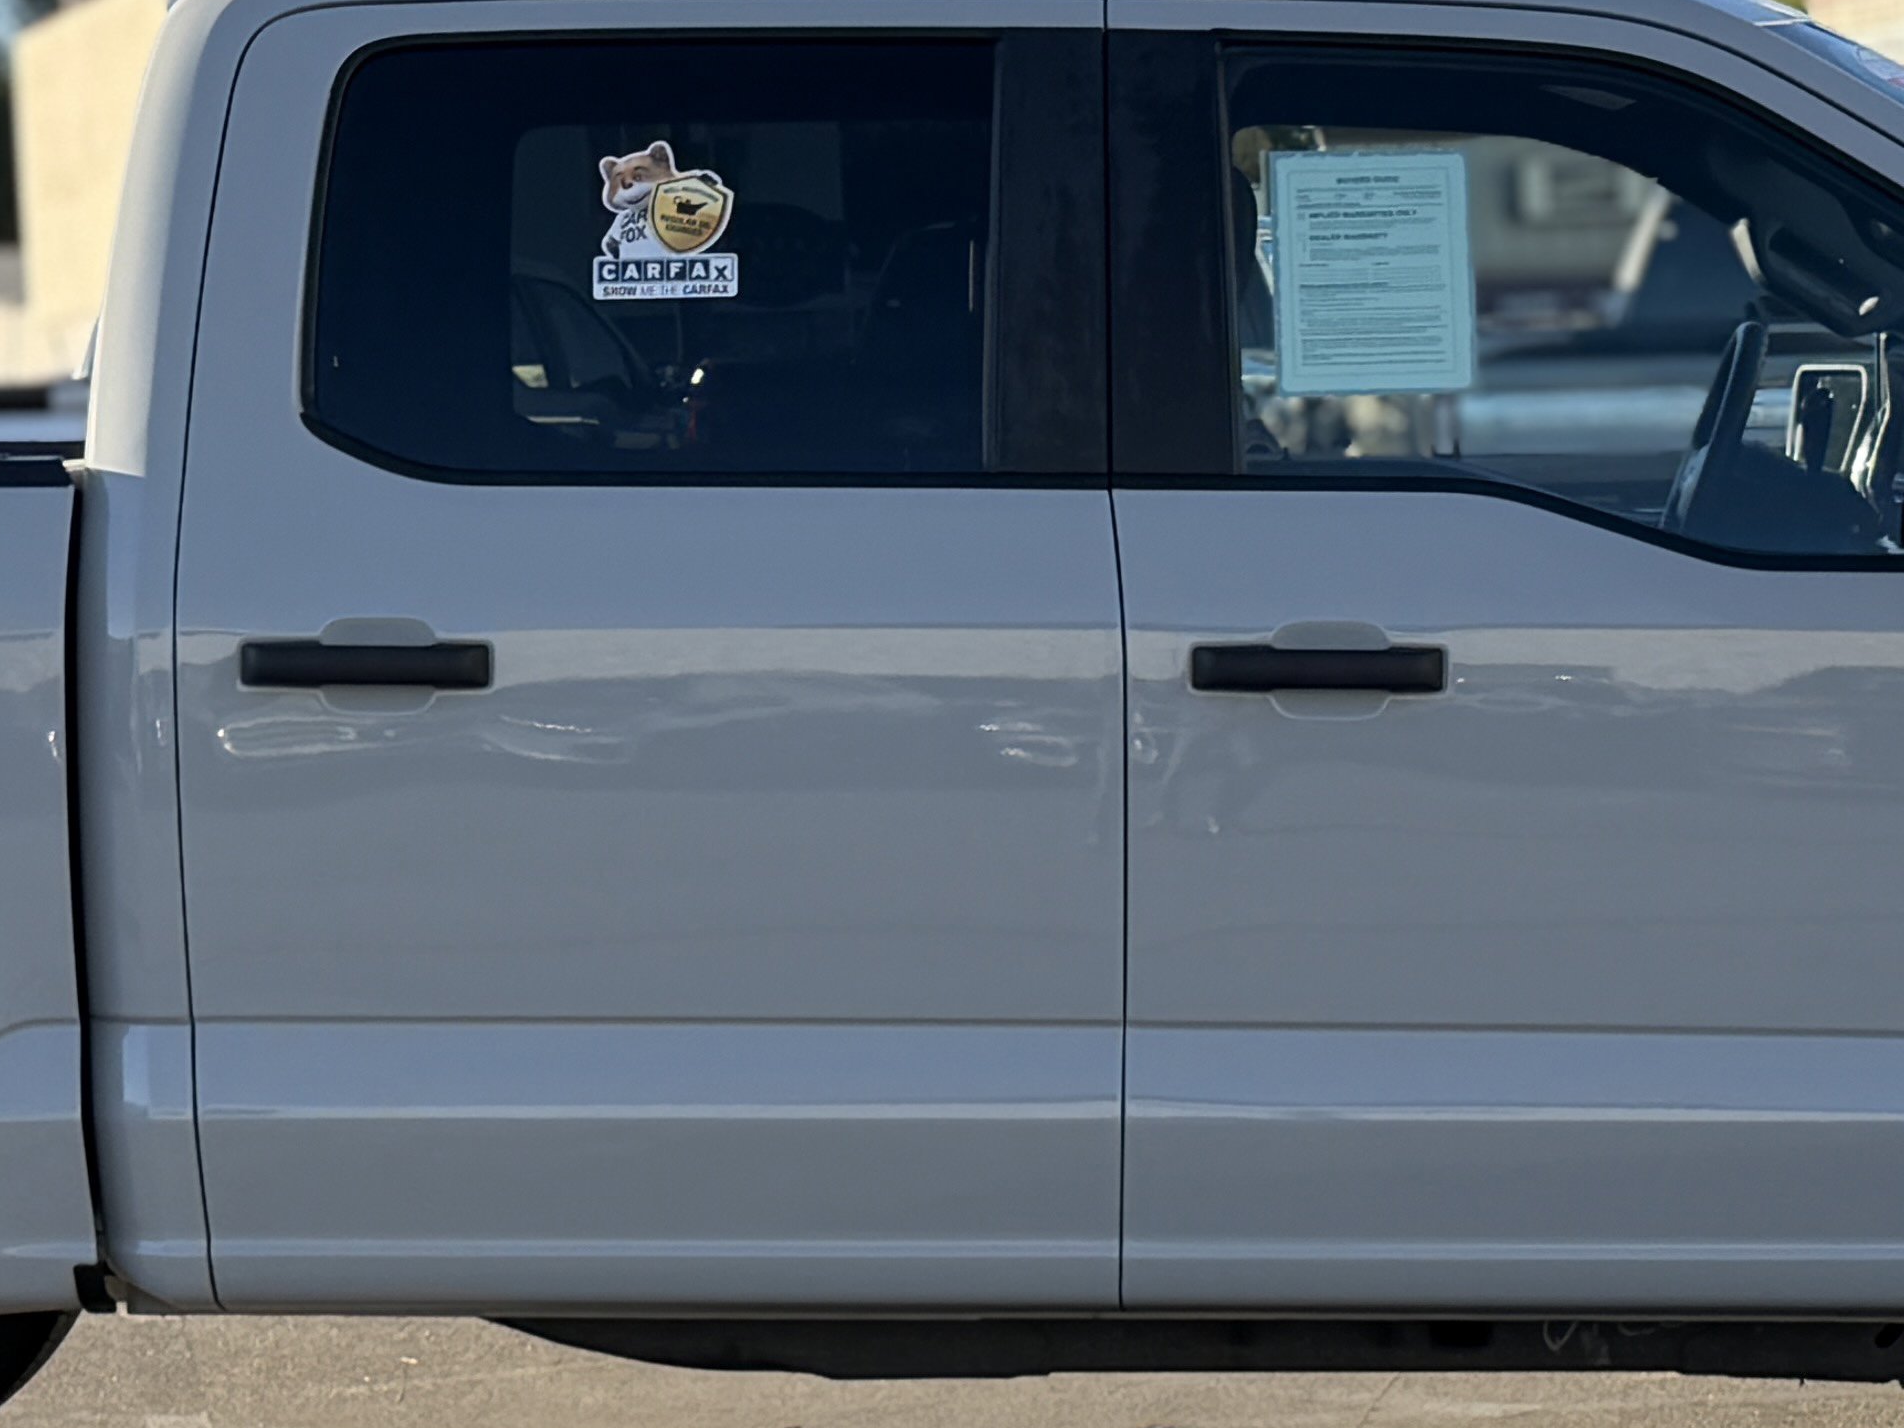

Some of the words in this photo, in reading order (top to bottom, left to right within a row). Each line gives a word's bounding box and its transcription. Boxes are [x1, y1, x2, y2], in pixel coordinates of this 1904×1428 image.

[621, 224, 648, 243] FOX
[601, 261, 729, 281] CARFAX
[603, 285, 638, 296] SHOW
[682, 283, 730, 295] CARFAX
